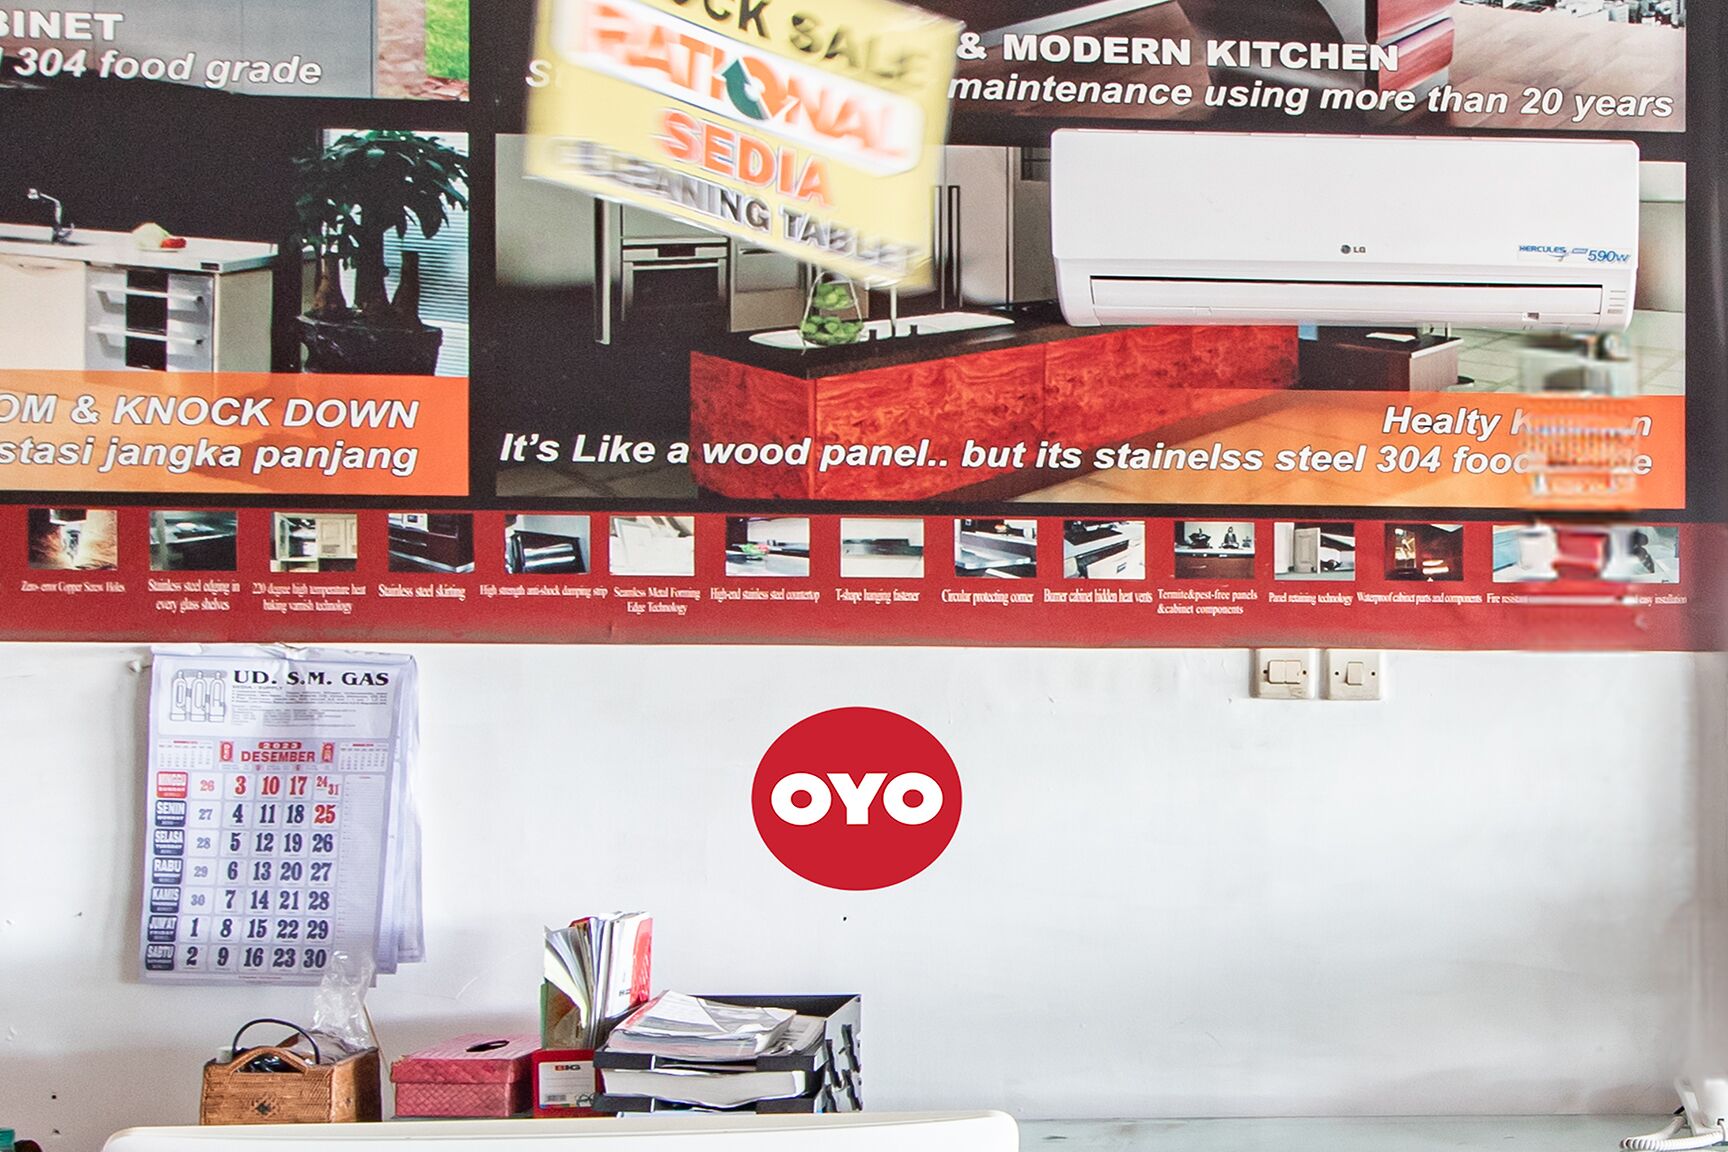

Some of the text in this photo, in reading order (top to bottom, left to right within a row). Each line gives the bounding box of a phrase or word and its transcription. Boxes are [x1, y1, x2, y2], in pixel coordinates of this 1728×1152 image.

[956, 32, 1399, 72] & MODERN KITCHEN
[14, 47, 88, 78] 304
[99, 49, 194, 81] food
[205, 55, 323, 89] grade
[947, 73, 1674, 123] maintenance using more than 20 years
[660, 109, 833, 208] SEDIA
[70, 394, 100, 424] &
[112, 394, 274, 428] KNOCK
[282, 398, 420, 430] DOWN
[1382, 405, 1502, 442] Healty
[98, 436, 242, 474] jangka
[252, 439, 419, 477] panjang
[500, 432, 560, 463] It's
[571, 433, 656, 464] Like
[666, 442, 690, 464] a
[702, 437, 812, 466] wood
[819, 438, 949, 473] panel..
[961, 439, 1027, 469] but
[1035, 440, 1083, 469] its
[1093, 441, 1265, 472] stainelss
[1274, 443, 1368, 473] steel
[1376, 444, 1441, 474] 304
[148, 579, 181, 593] Stainless
[183, 579, 201, 593] steel
[378, 583, 413, 597] Stainless
[415, 583, 434, 597] steel
[941, 589, 971, 602] Circular
[1069, 589, 1093, 603] cabinet
[1095, 589, 1117, 603] hidden
[1118, 590, 1133, 603] heat
[1232, 589, 1258, 602] panels
[648, 602, 687, 616] Technology
[1196, 604, 1244, 617] components
[234, 670, 389, 686] UD. S.M. GAS
[262, 742, 299, 750] 2023
[240, 751, 316, 763] DESEMBER
[235, 776, 247, 795] 3
[261, 776, 280, 795] 10
[289, 777, 308, 795] 17
[316, 776, 327, 788] 24
[328, 784, 339, 796] 31
[771, 772, 943, 826] OYO
[232, 804, 244, 823] 4
[259, 804, 276, 824] 11
[286, 804, 304, 824] 18
[314, 804, 336, 824] 25
[230, 832, 241, 852] 5
[255, 833, 274, 852] 12
[283, 833, 303, 853] 19
[312, 834, 334, 853] 26
[154, 859, 182, 872] RABU
[227, 861, 238, 880] 6
[253, 862, 272, 881] 13
[280, 862, 302, 881] 20
[310, 862, 332, 881] 27
[225, 890, 237, 909] 7
[251, 891, 270, 910] 14
[279, 891, 299, 910] 21
[308, 891, 330, 910] 28
[190, 917, 329, 939] 1 8 15 22 29
[186, 946, 199, 966] 2
[217, 947, 229, 967] 9
[243, 948, 264, 967] 16
[273, 949, 296, 968] 23
[303, 949, 327, 968] 30
[554, 1064, 581, 1072] BIG
